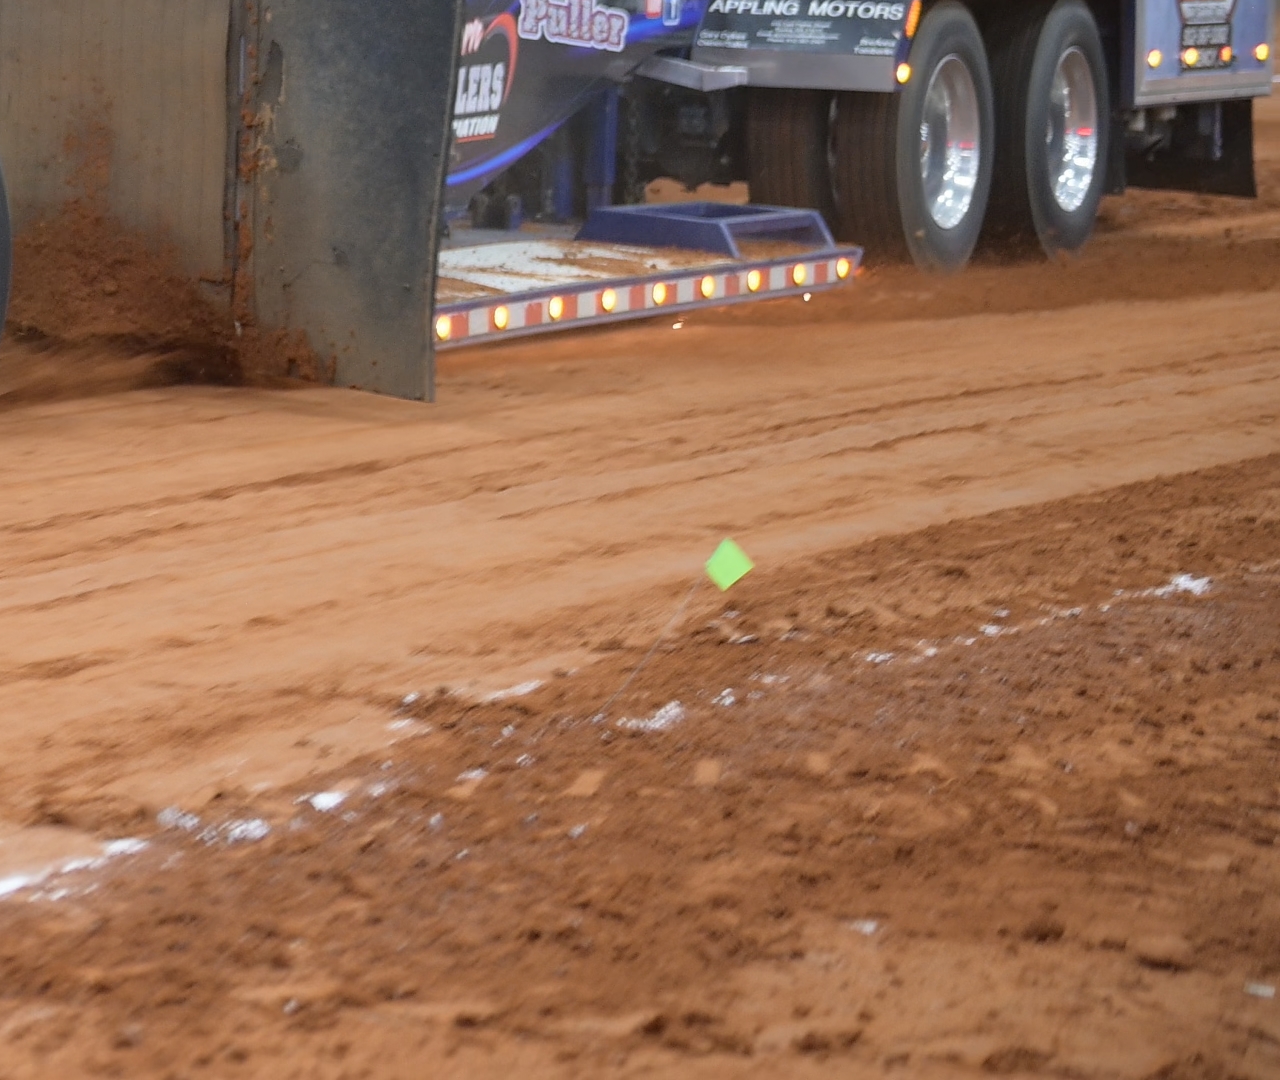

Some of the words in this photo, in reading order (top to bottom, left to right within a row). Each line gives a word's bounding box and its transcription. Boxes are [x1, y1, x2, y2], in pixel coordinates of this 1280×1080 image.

[807, 0, 904, 21] MOTORS
[454, 62, 506, 116] LERS
[452, 113, 501, 139] IATION
